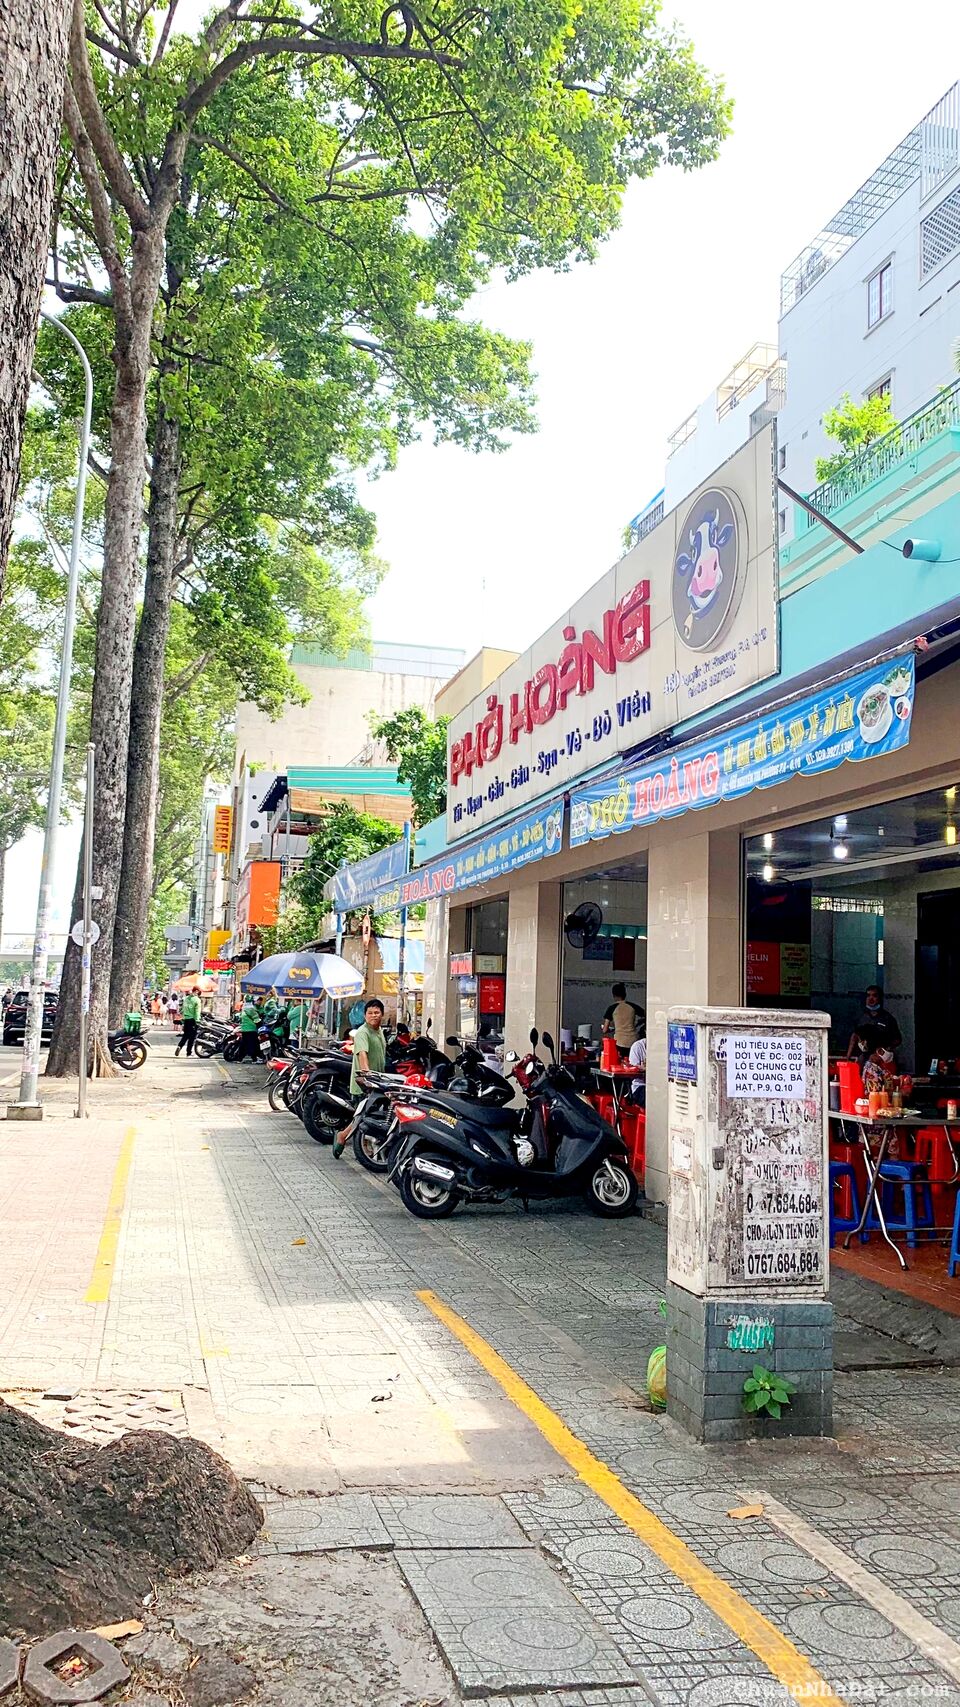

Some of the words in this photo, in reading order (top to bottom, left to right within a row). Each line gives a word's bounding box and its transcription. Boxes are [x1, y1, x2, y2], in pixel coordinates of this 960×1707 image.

[450, 695, 503, 786] PHỞ
[509, 579, 650, 745] HOÀNG
[467, 795, 483, 817] Nạm
[488, 776, 505, 802] Gầu
[537, 751, 558, 776] Sụn
[566, 728, 582, 756] Vè
[593, 709, 612, 743] Bò
[616, 689, 651, 727] Viên
[588, 775, 631, 833] PHỞ
[632, 751, 720, 820] HOÀNG
[401, 865, 456, 904] HOÀNG
[770, 1042, 783, 1050] SA
[788, 1053, 802, 1061] 002
[756, 1063, 787, 1071] CHUNG
[789, 1063, 803, 1071] CƯ
[752, 1073, 786, 1082] QUANG,
[735, 1083, 756, 1093] HẠT,
[757, 1084, 773, 1092] P.9,
[774, 1084, 793, 1092] Q.10
[747, 1193, 818, 1214] 07.684.684
[746, 1224, 762, 1241] CHO
[747, 1252, 819, 1275] 0767.684.684
